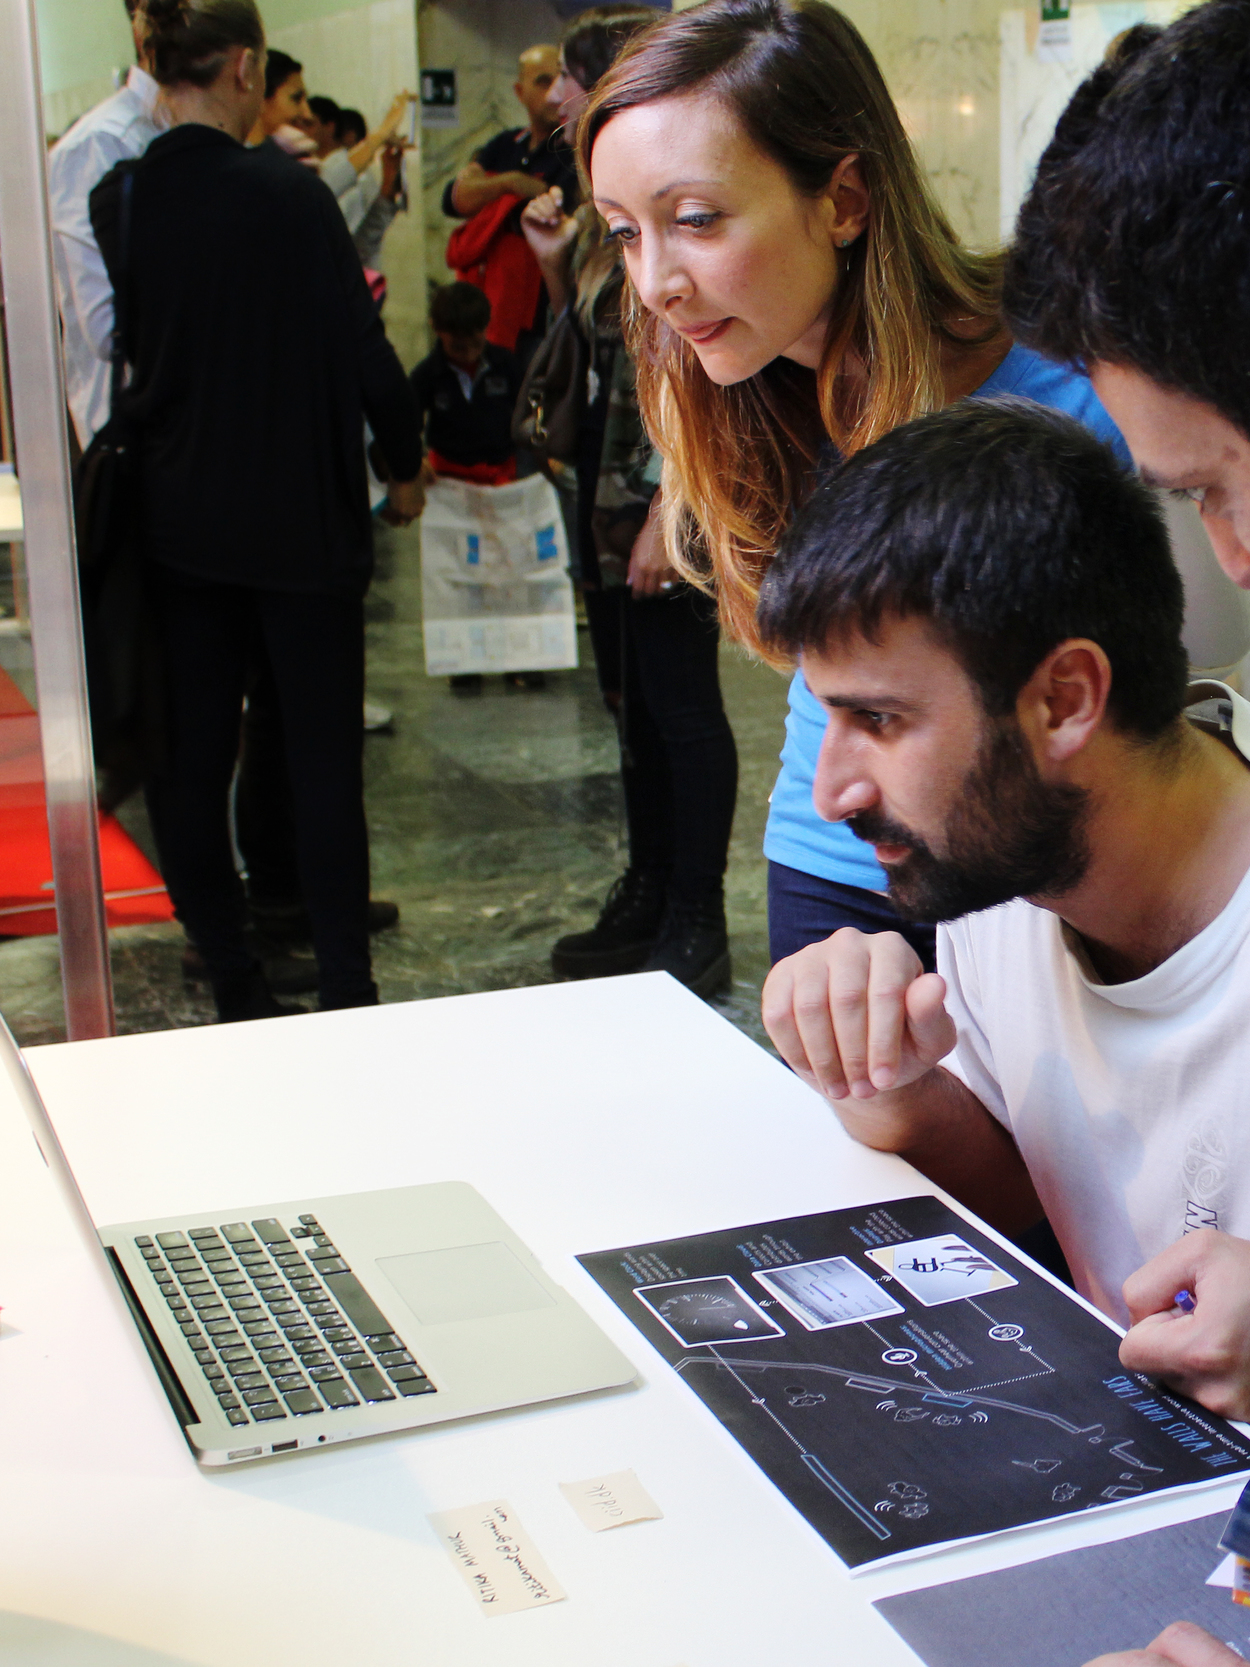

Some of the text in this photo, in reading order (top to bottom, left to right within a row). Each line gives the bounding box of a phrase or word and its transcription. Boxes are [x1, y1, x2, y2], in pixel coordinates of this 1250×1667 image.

[1102, 1375, 1144, 1399] EARS
[1129, 1399, 1174, 1422] HAVE
[1180, 1407, 1217, 1435] interactive
[1160, 1422, 1213, 1453] WALLS
[1215, 1433, 1249, 1456] real-time
[1200, 1451, 1238, 1467] THE
[473, 1572, 500, 1603] RITIKA
